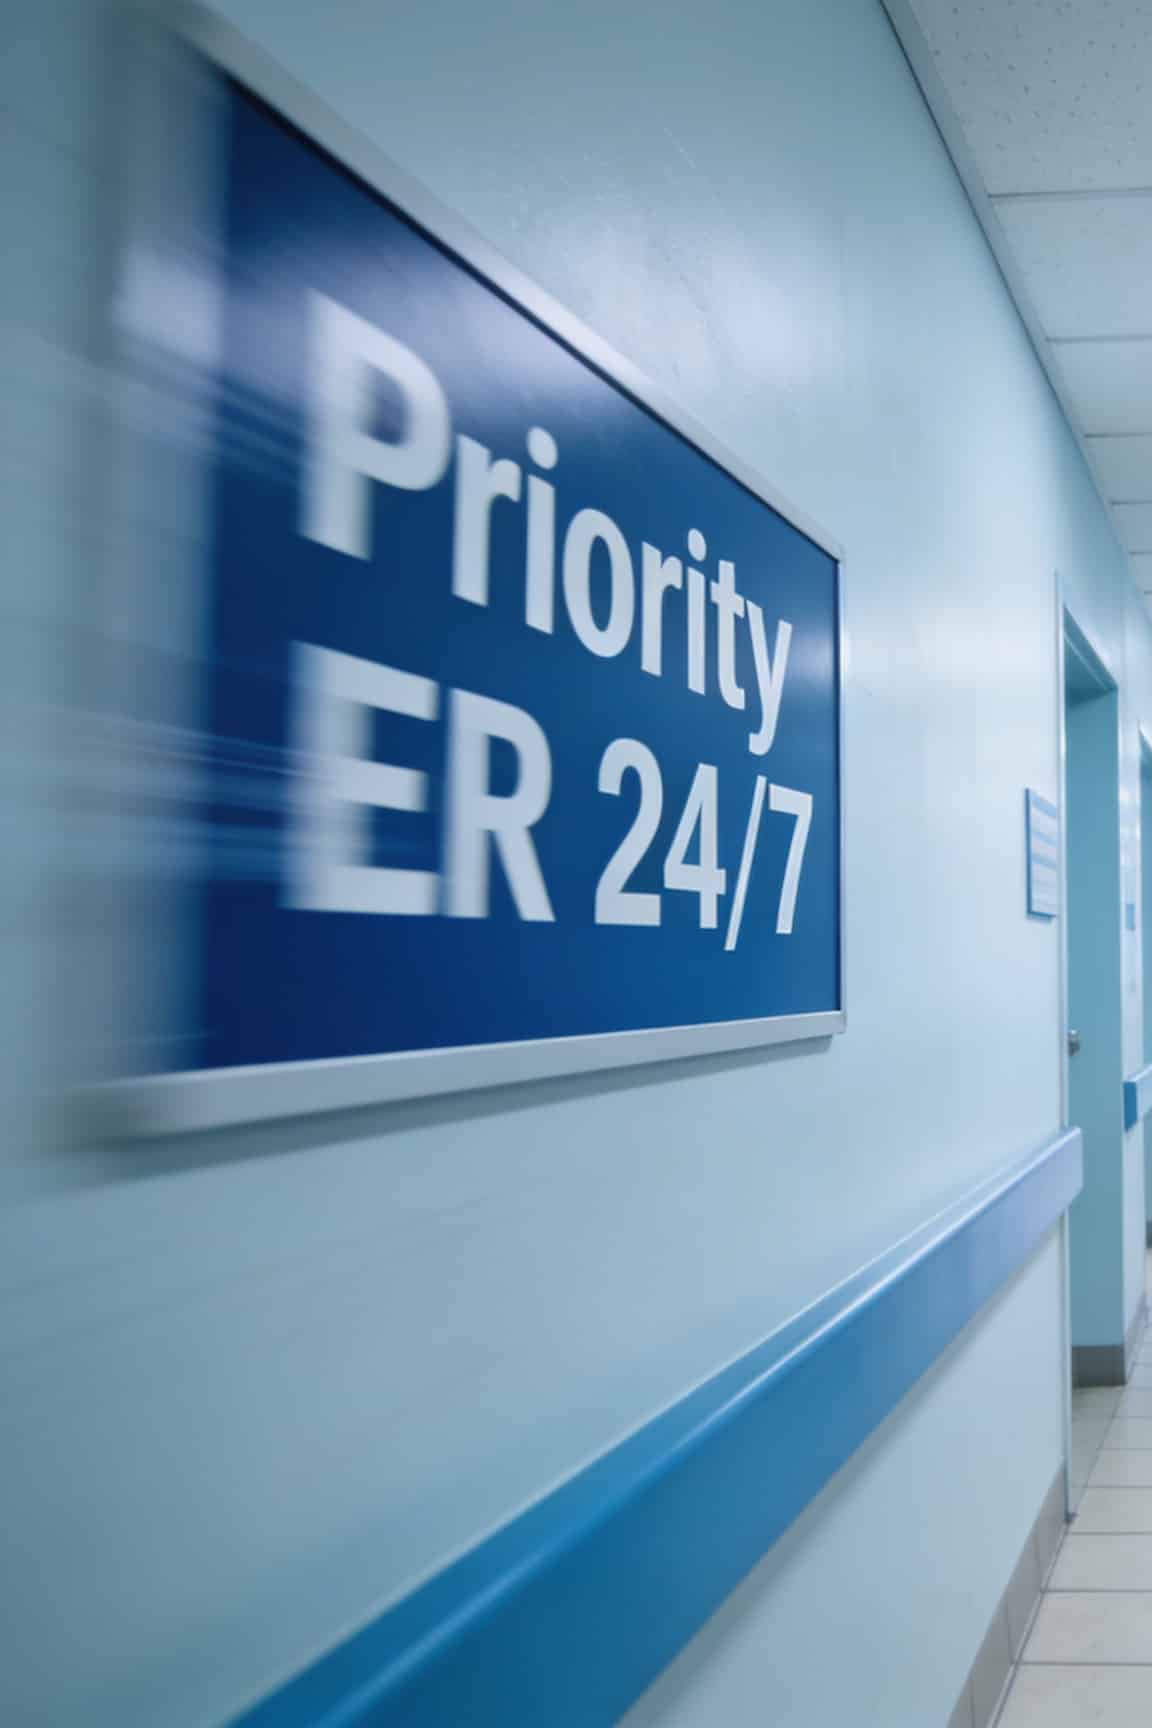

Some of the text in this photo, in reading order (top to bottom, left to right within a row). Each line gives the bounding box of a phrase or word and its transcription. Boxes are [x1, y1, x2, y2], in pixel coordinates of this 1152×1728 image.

[299, 288, 793, 757] Priority
[284, 639, 813, 951] ER 24/7
